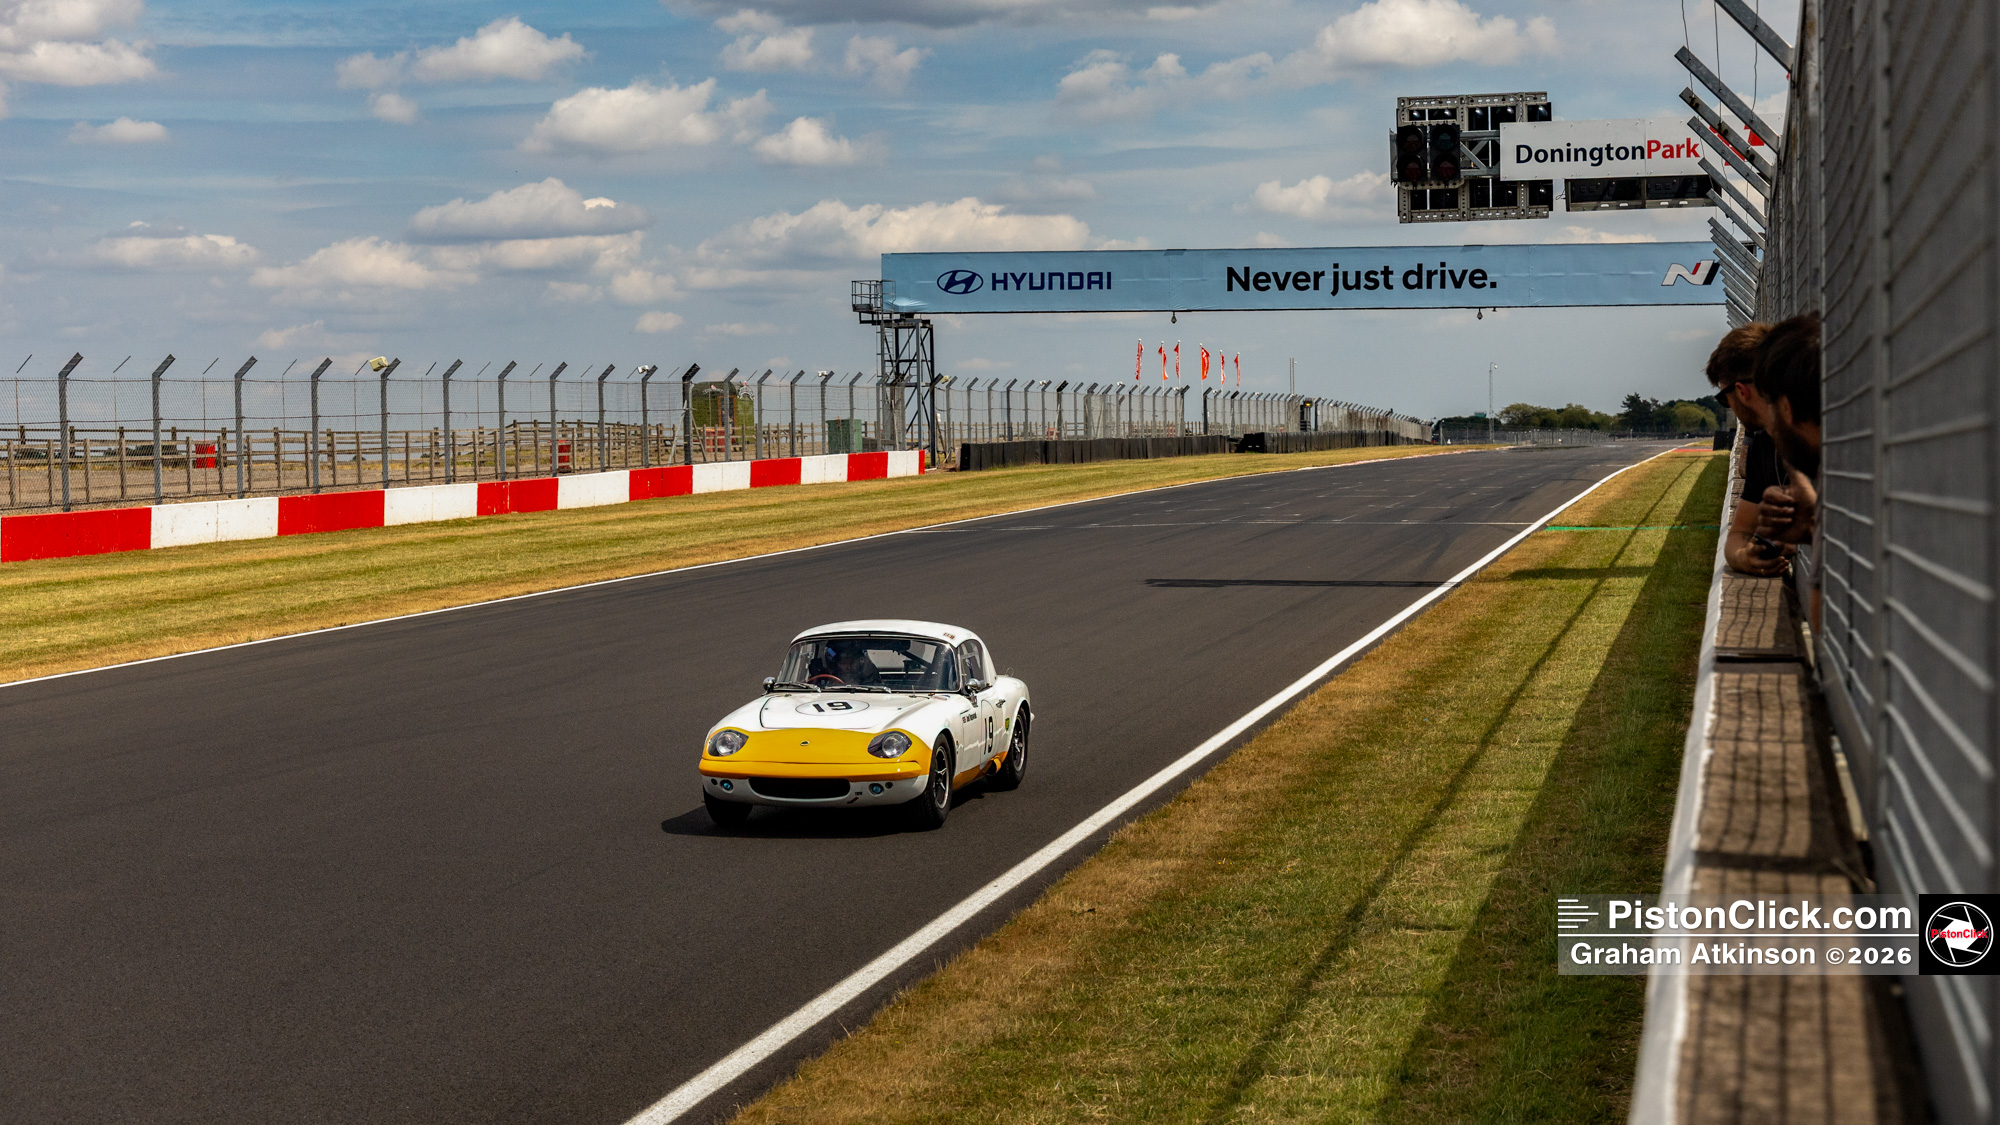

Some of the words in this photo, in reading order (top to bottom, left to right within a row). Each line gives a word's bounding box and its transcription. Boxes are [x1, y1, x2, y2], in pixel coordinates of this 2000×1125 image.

[1515, 138, 1700, 167] DoningtonPark
[991, 271, 1112, 291] HYUNDAI
[1226, 266, 1325, 292] Never
[1331, 263, 1394, 297] just
[1402, 262, 1497, 289] drive.
[812, 701, 853, 713] 19
[983, 715, 994, 755] 19
